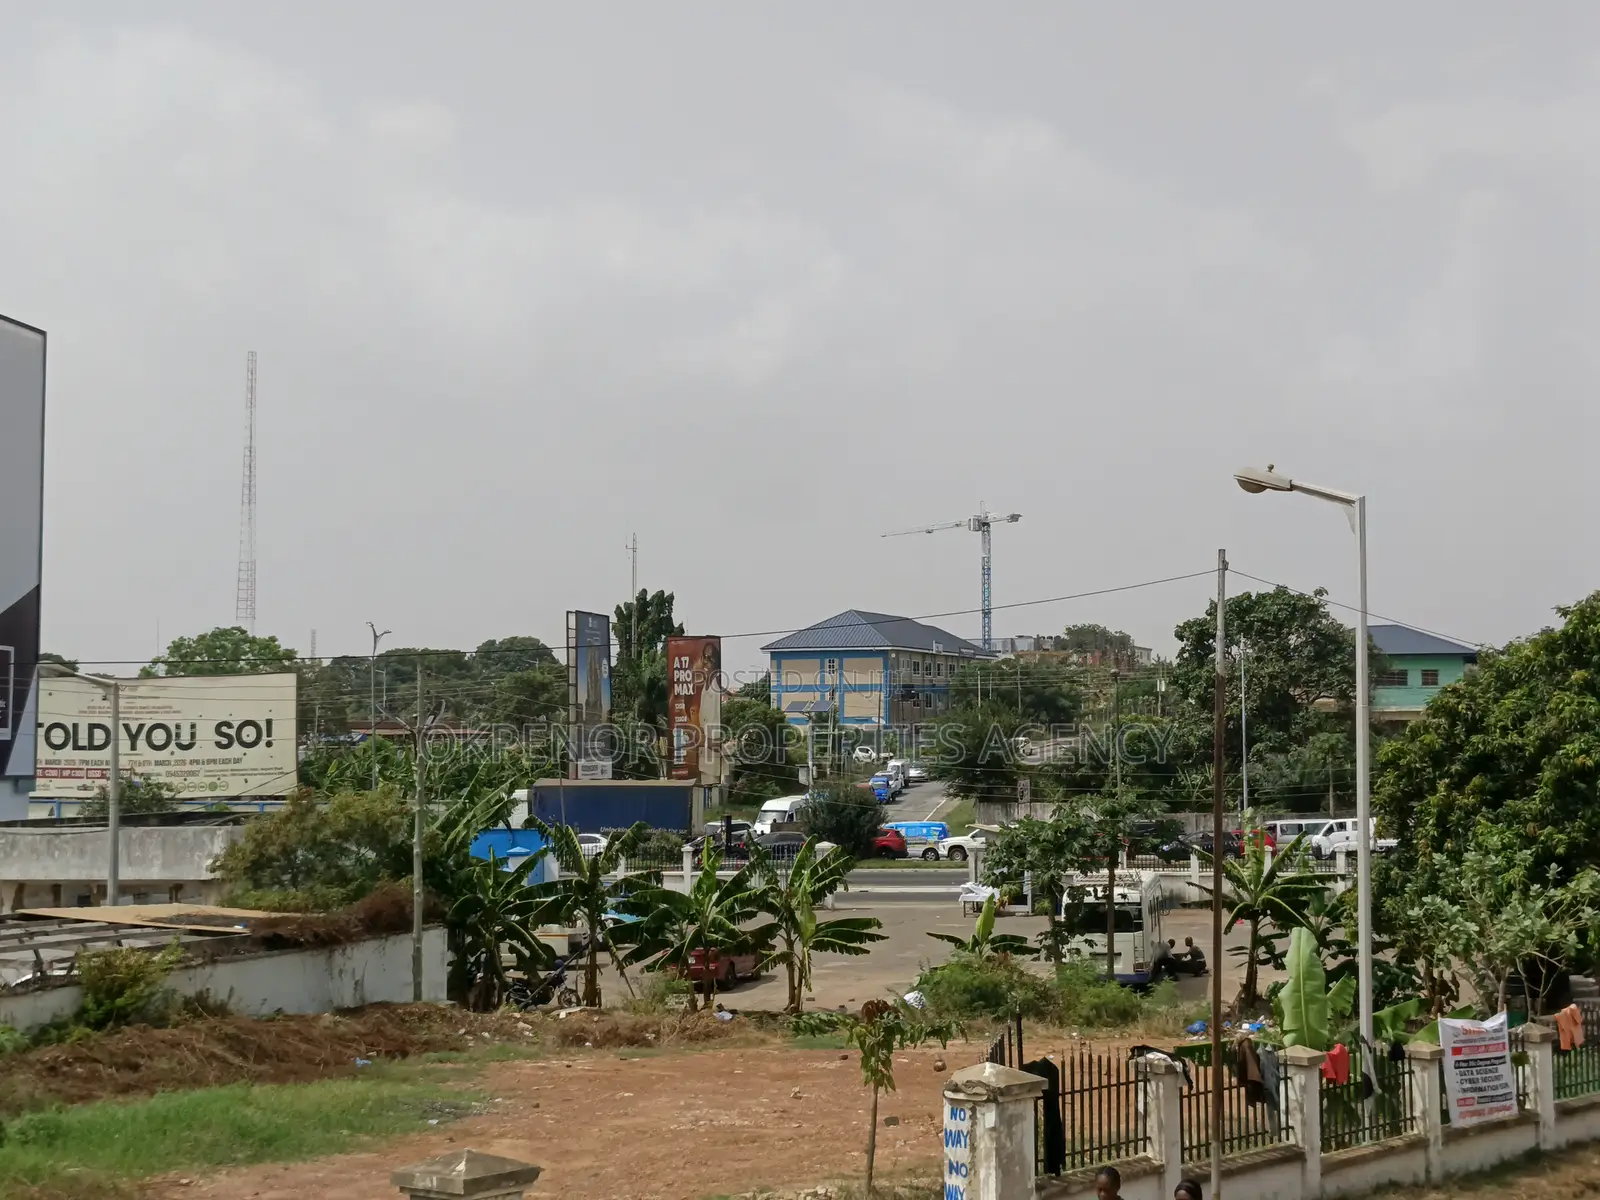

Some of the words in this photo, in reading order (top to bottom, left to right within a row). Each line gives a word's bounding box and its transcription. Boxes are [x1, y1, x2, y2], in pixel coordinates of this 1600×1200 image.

[673, 656, 681, 669] A
[681, 656, 690, 669] 17
[673, 669, 693, 682] PRO
[674, 683, 694, 696] MAX
[122, 722, 197, 751] YOU
[214, 718, 274, 750] SO!
[154, 759, 172, 767] MARCH
[218, 757, 232, 765] EACH
[232, 757, 243, 765] DAY
[600, 825, 630, 834] Unlockin
[1459, 1069, 1475, 1077] DATA
[1460, 1077, 1480, 1085] CYBER
[950, 1107, 967, 1122] NO
[944, 1127, 970, 1149] WAY
[948, 1158, 969, 1179] NO
[944, 1182, 966, 1200] WAY
